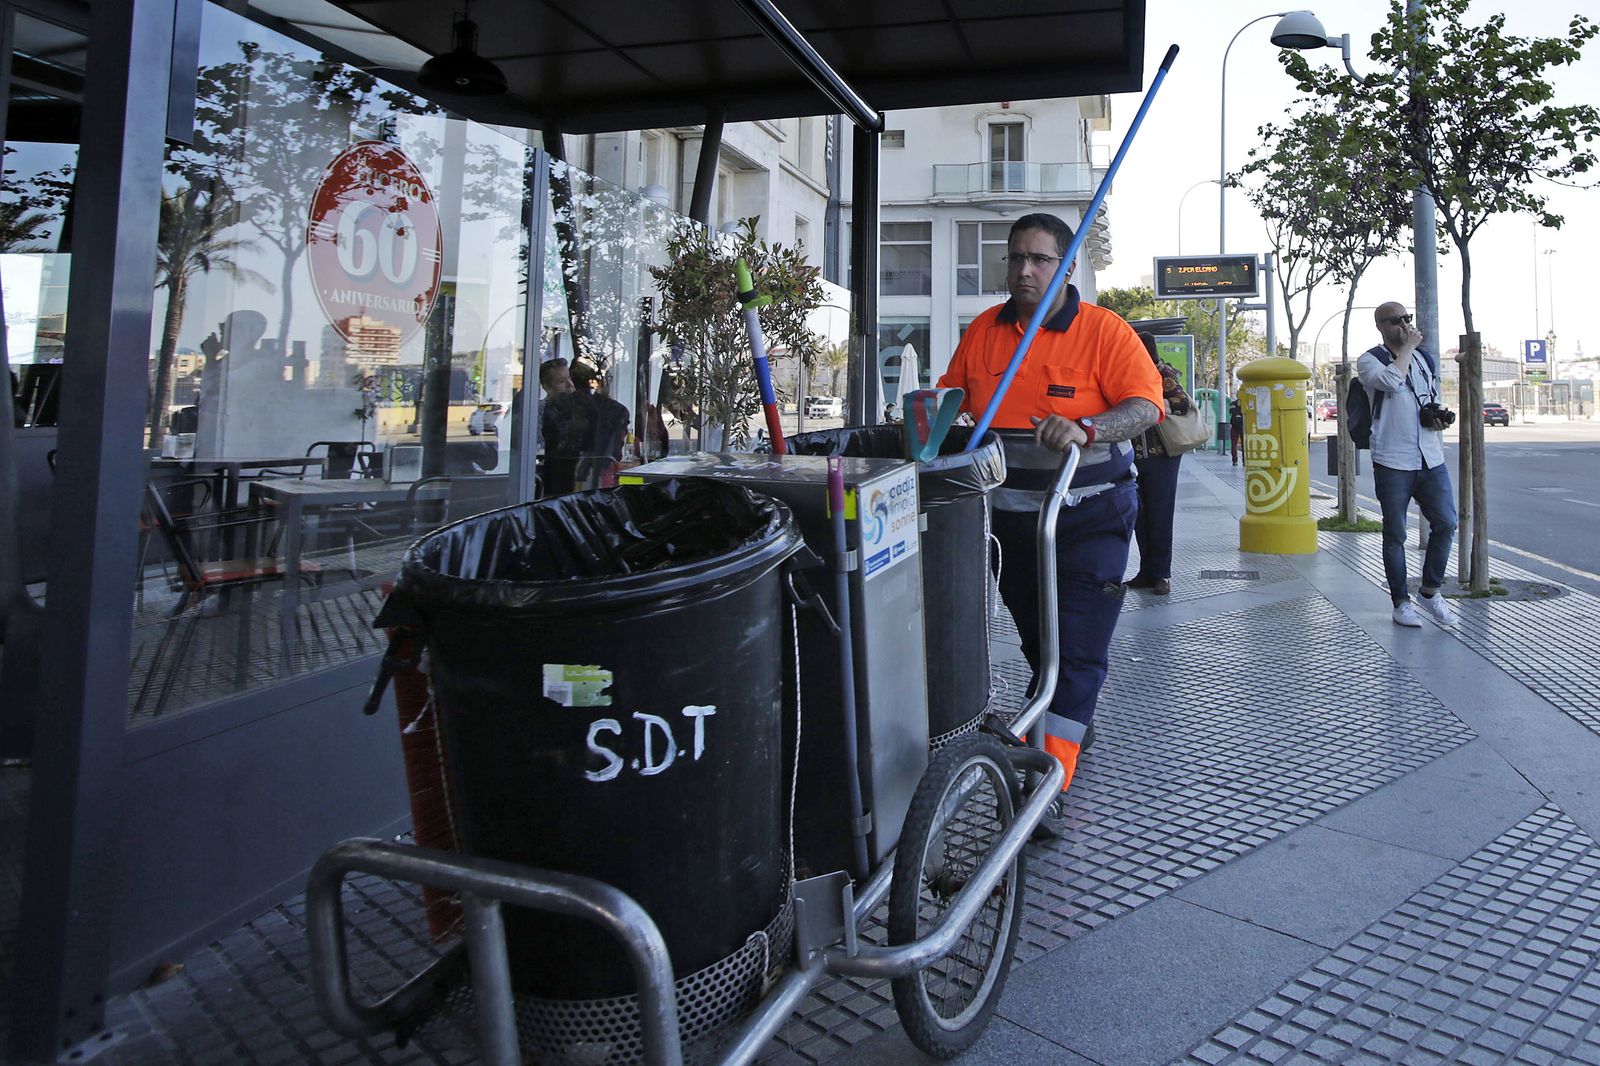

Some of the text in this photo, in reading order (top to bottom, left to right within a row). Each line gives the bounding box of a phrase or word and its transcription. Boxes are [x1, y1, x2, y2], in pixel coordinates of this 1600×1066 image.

[337, 200, 418, 284] 60
[330, 287, 420, 315] ANIVERSARIO
[1530, 342, 1541, 357] P
[889, 475, 915, 499] cádiz
